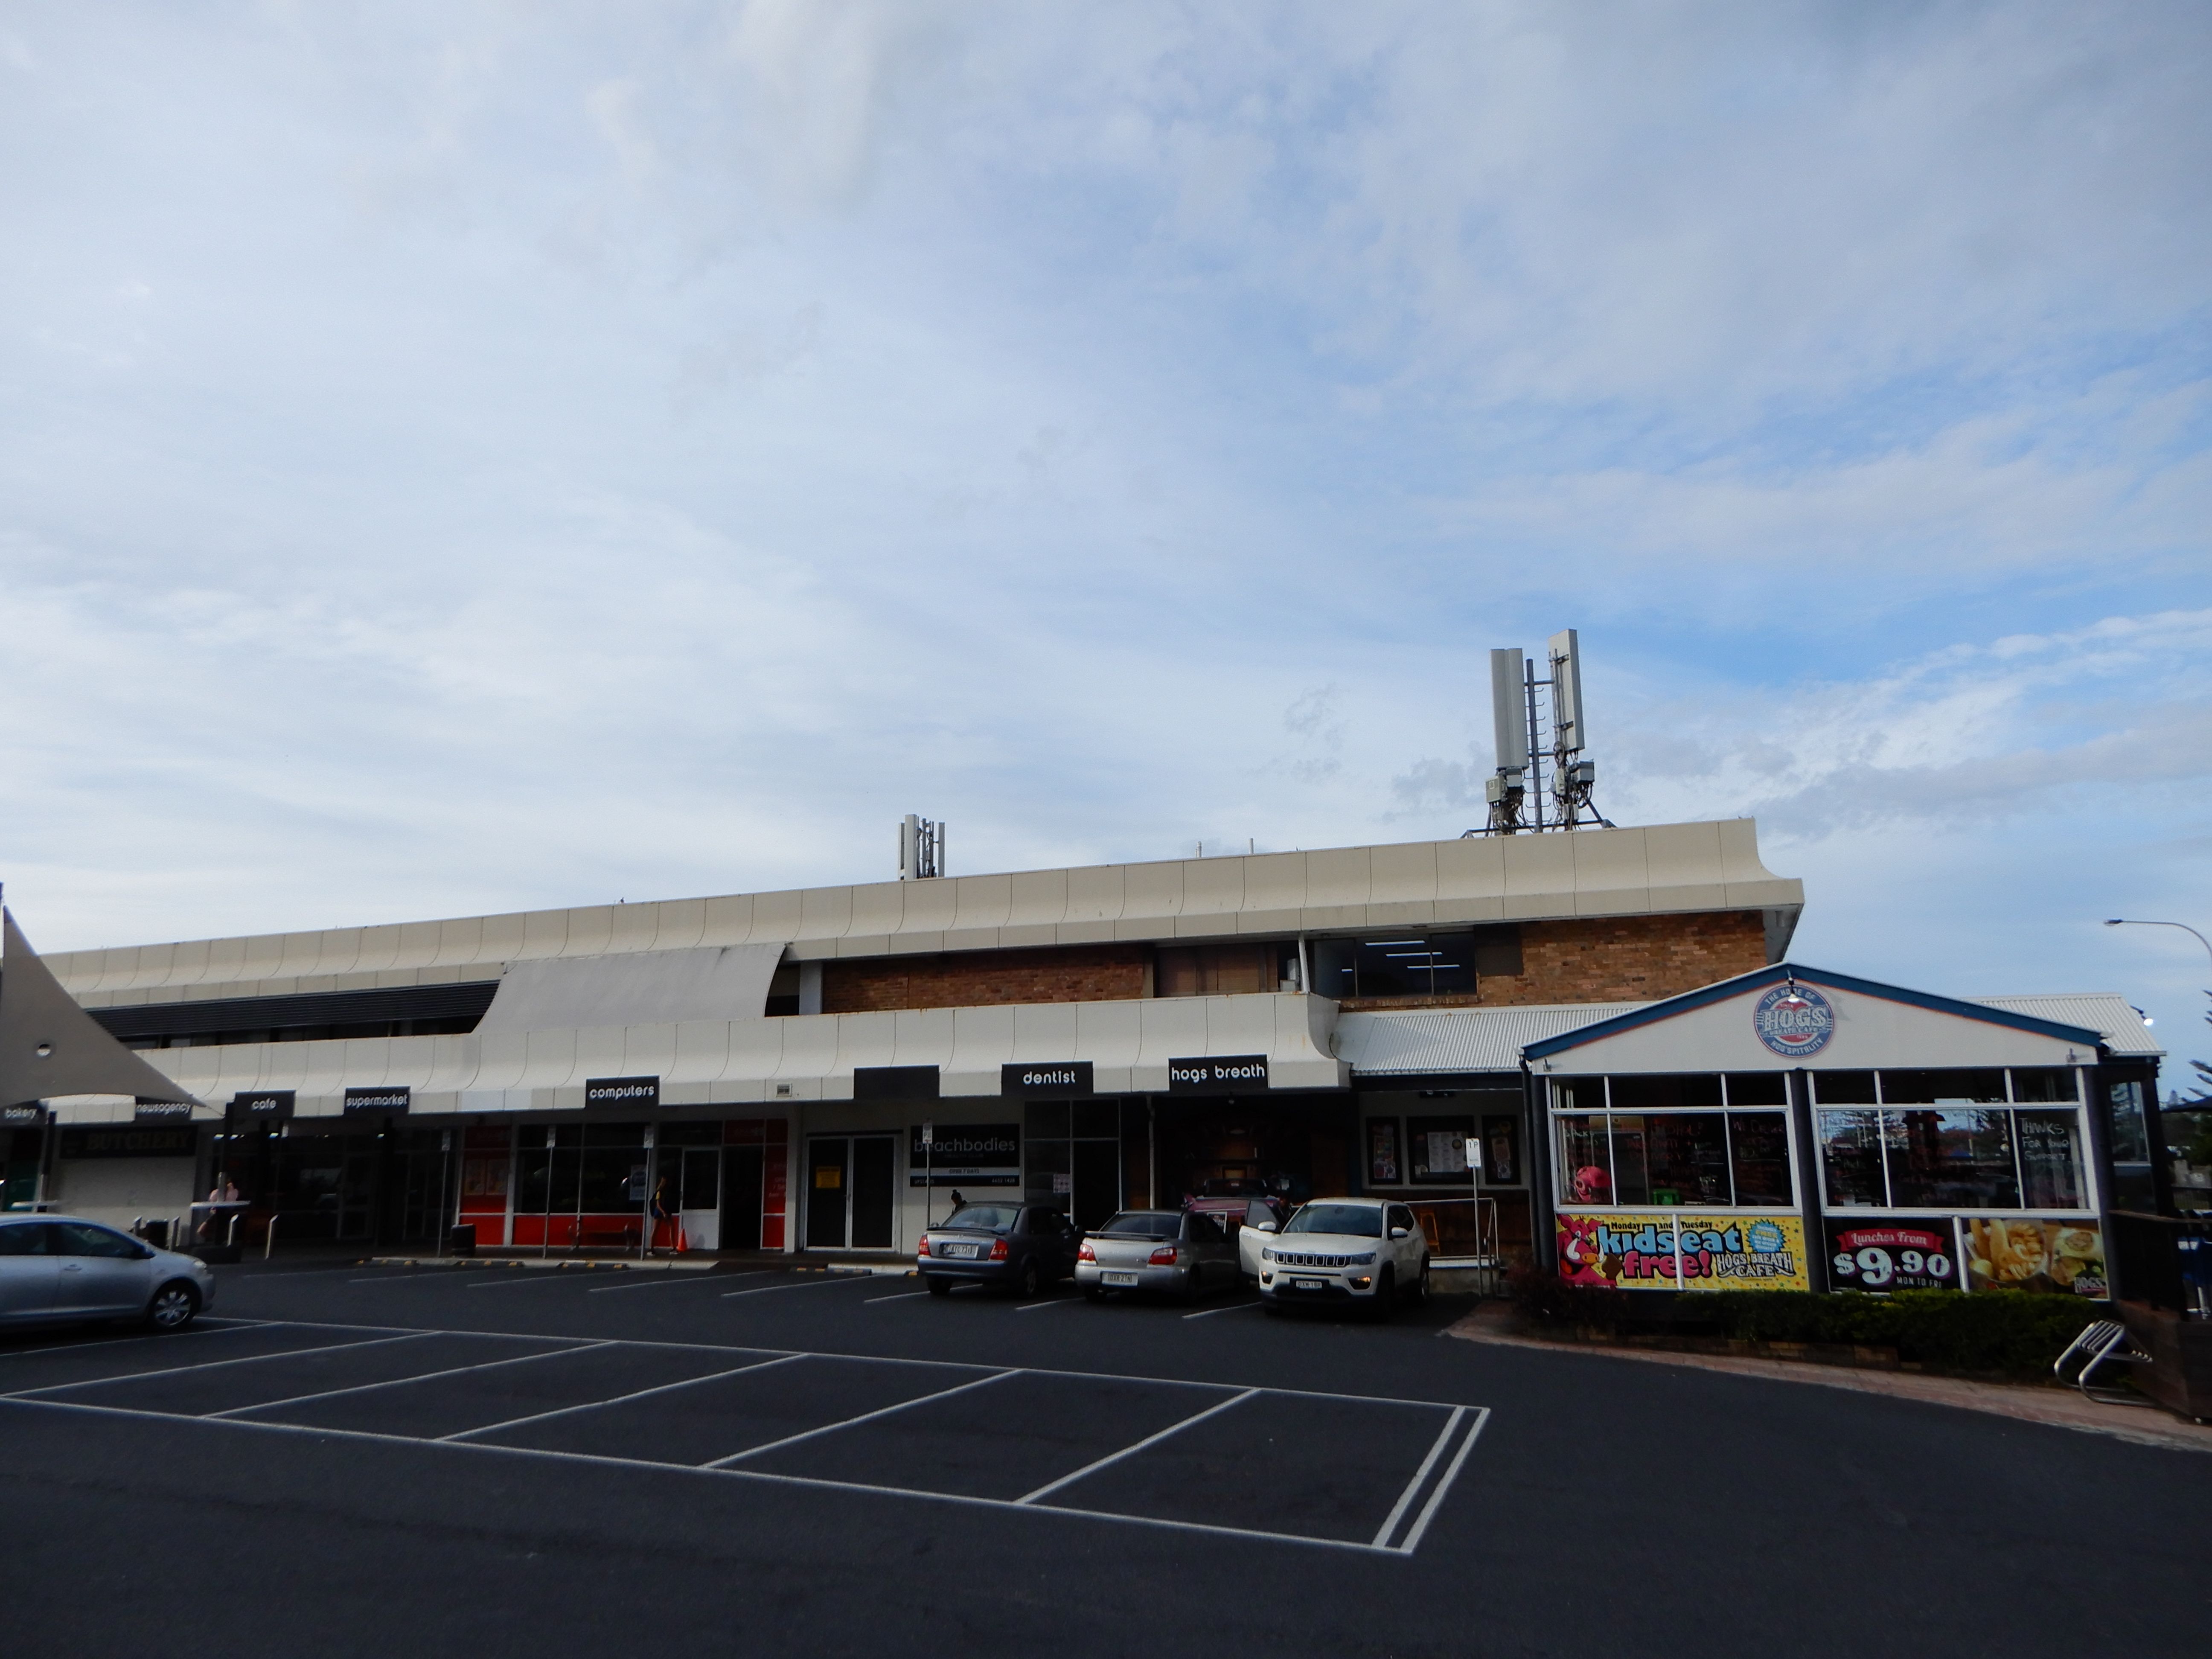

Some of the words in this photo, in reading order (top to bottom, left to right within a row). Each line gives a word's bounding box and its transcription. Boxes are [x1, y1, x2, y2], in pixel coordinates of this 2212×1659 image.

[1764, 992, 1779, 1005] THE
[1805, 990, 1816, 1000] OF
[1762, 1006, 1827, 1033] HOGS
[1022, 1069, 1076, 1085] dentist
[1172, 1066, 1208, 1084] hogs
[1215, 1063, 1265, 1079] breath
[588, 1084, 655, 1101] computers
[136, 1102, 191, 1115] newsagency
[251, 1098, 276, 1110] cafe
[346, 1094, 407, 1109] supermarket
[5, 1108, 37, 1120] bakery
[87, 1131, 190, 1150] BUTCHERY
[914, 1137, 1016, 1152] beachbodies
[1611, 1222, 1640, 1231] Monday
[1659, 1221, 1674, 1229] and
[1680, 1221, 1713, 1229] Tuesday
[1598, 1225, 1675, 1254] kids
[1680, 1226, 1741, 1253] eat
[1851, 1231, 1894, 1246] Lunches
[1897, 1231, 1927, 1245] From
[1622, 1250, 1710, 1277] free!
[1715, 1253, 1747, 1272] HOGS
[1750, 1252, 1793, 1272] BREATH
[1833, 1247, 1951, 1284] $9.90
[1736, 1264, 1775, 1277] CAFE
[1896, 1276, 1914, 1285] MON
[1917, 1278, 1927, 1286] TO
[1929, 1279, 1942, 1288] FRI
